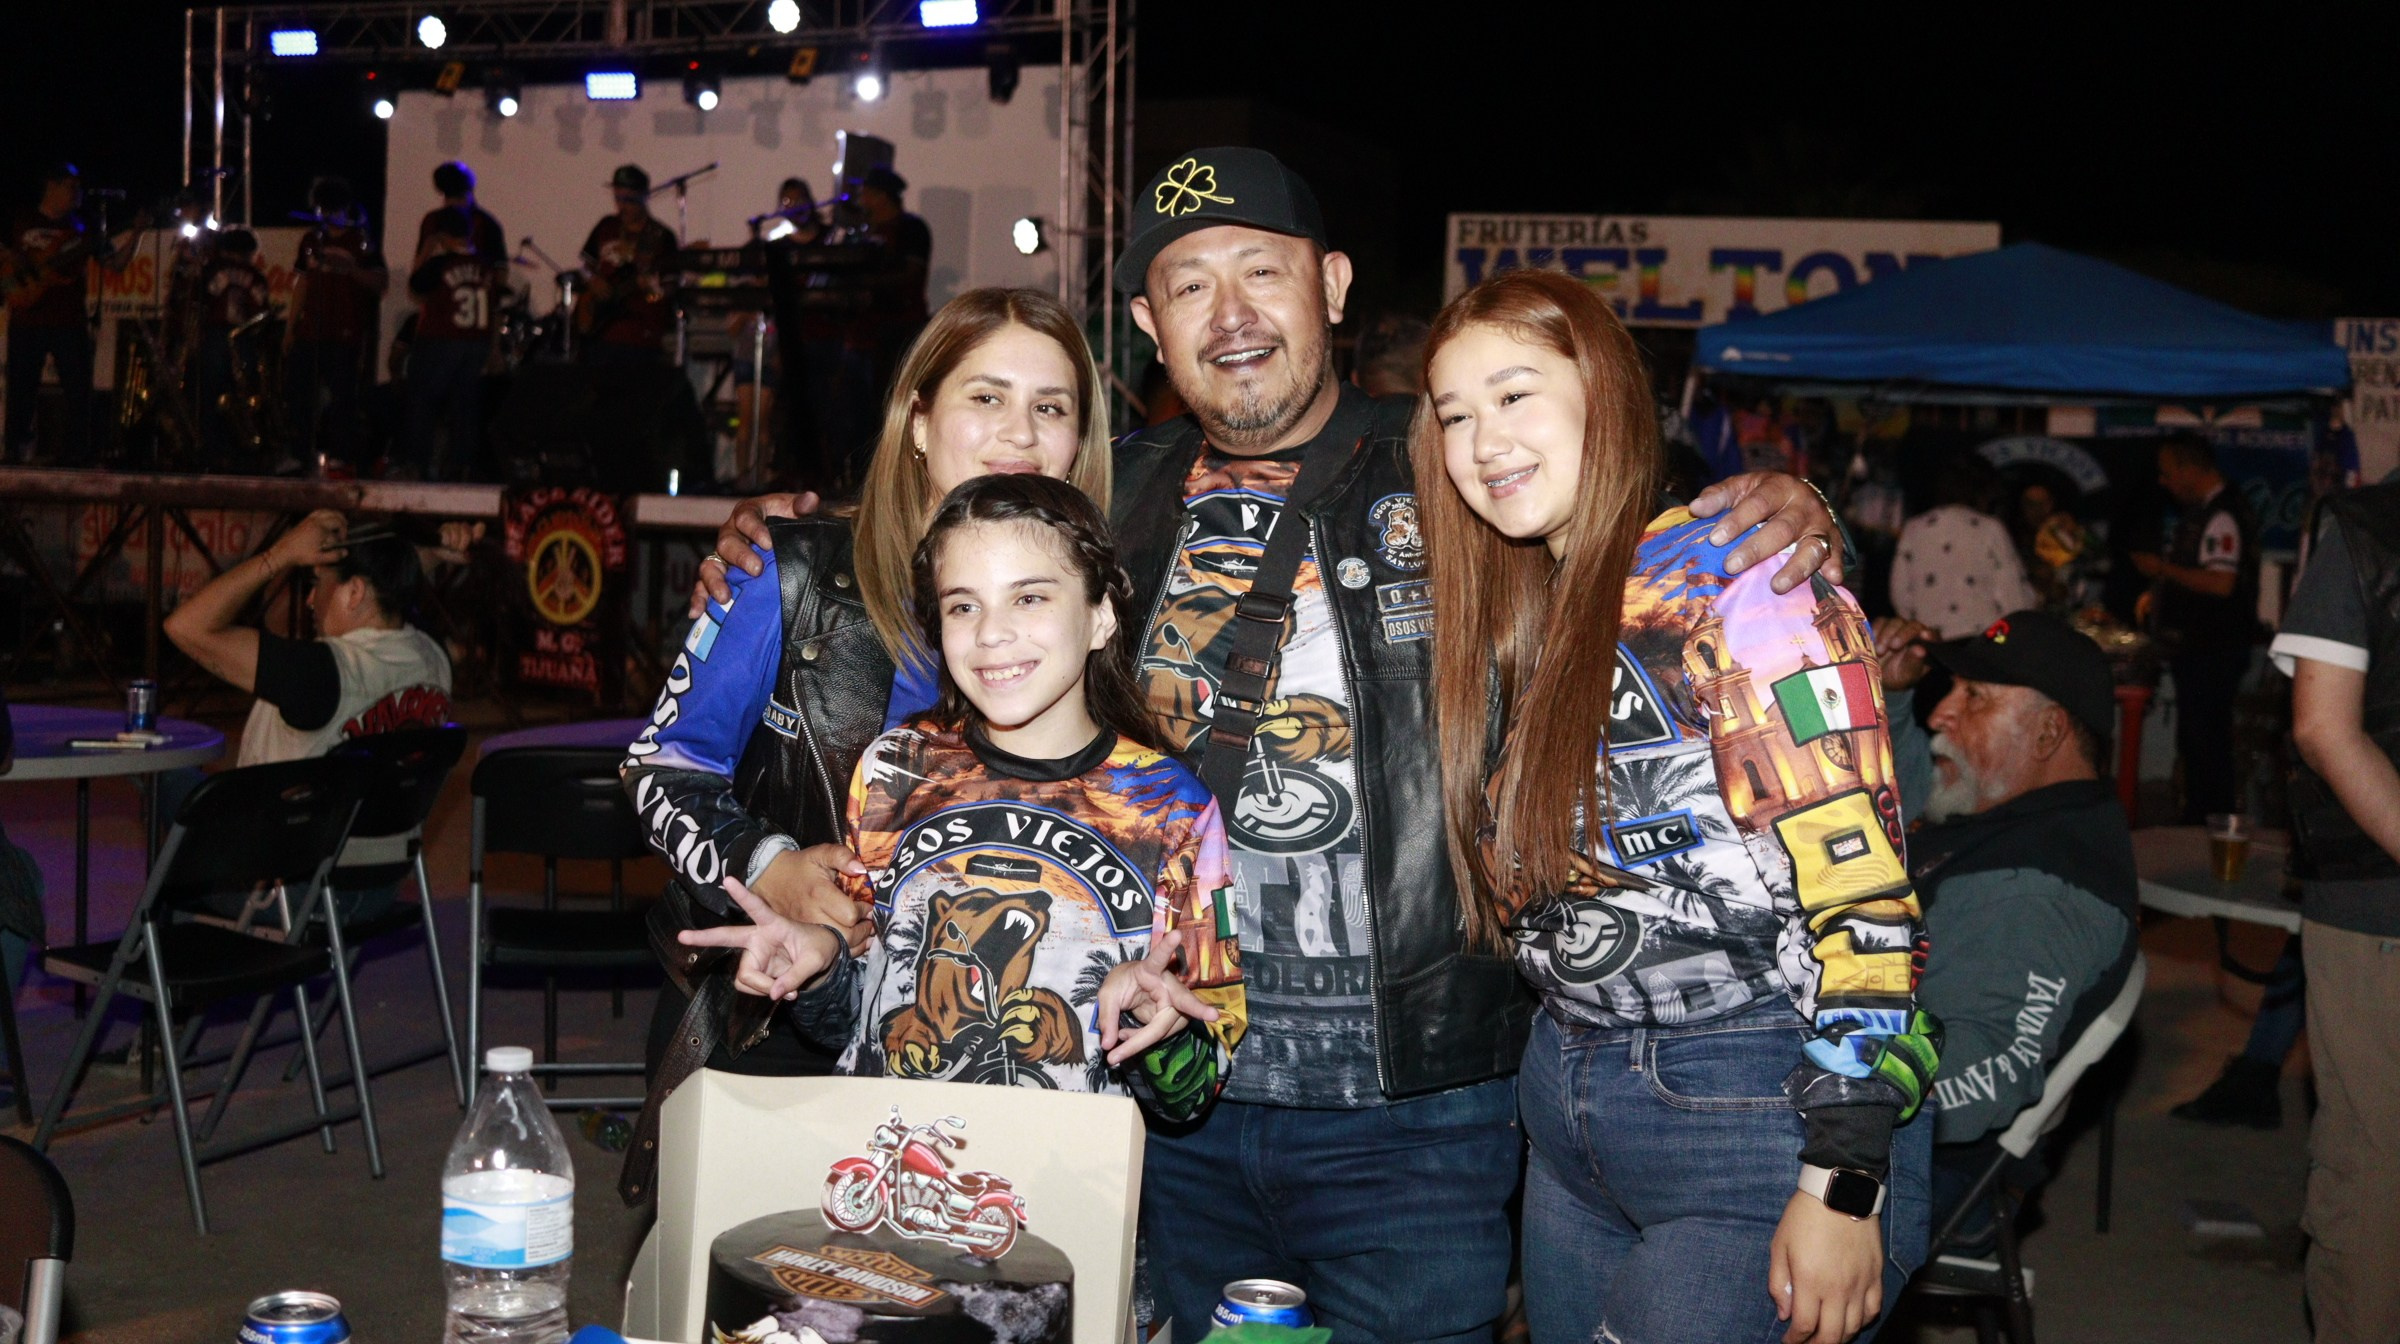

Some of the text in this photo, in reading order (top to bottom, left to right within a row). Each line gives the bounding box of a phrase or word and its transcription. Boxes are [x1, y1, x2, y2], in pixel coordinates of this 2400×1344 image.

[1458, 218, 1648, 244] FRUTERÍAS
[454, 286, 489, 330] 31
[1388, 620, 1418, 637] OSOS
[877, 817, 974, 891] OSOS
[1004, 811, 1143, 912] VIEJOS
[1994, 1053, 2019, 1084] &
[766, 1249, 933, 1302] HARLEY-DAVIDSON
[831, 1249, 915, 1279] MOTOR
[782, 1269, 867, 1299] CYCLES
